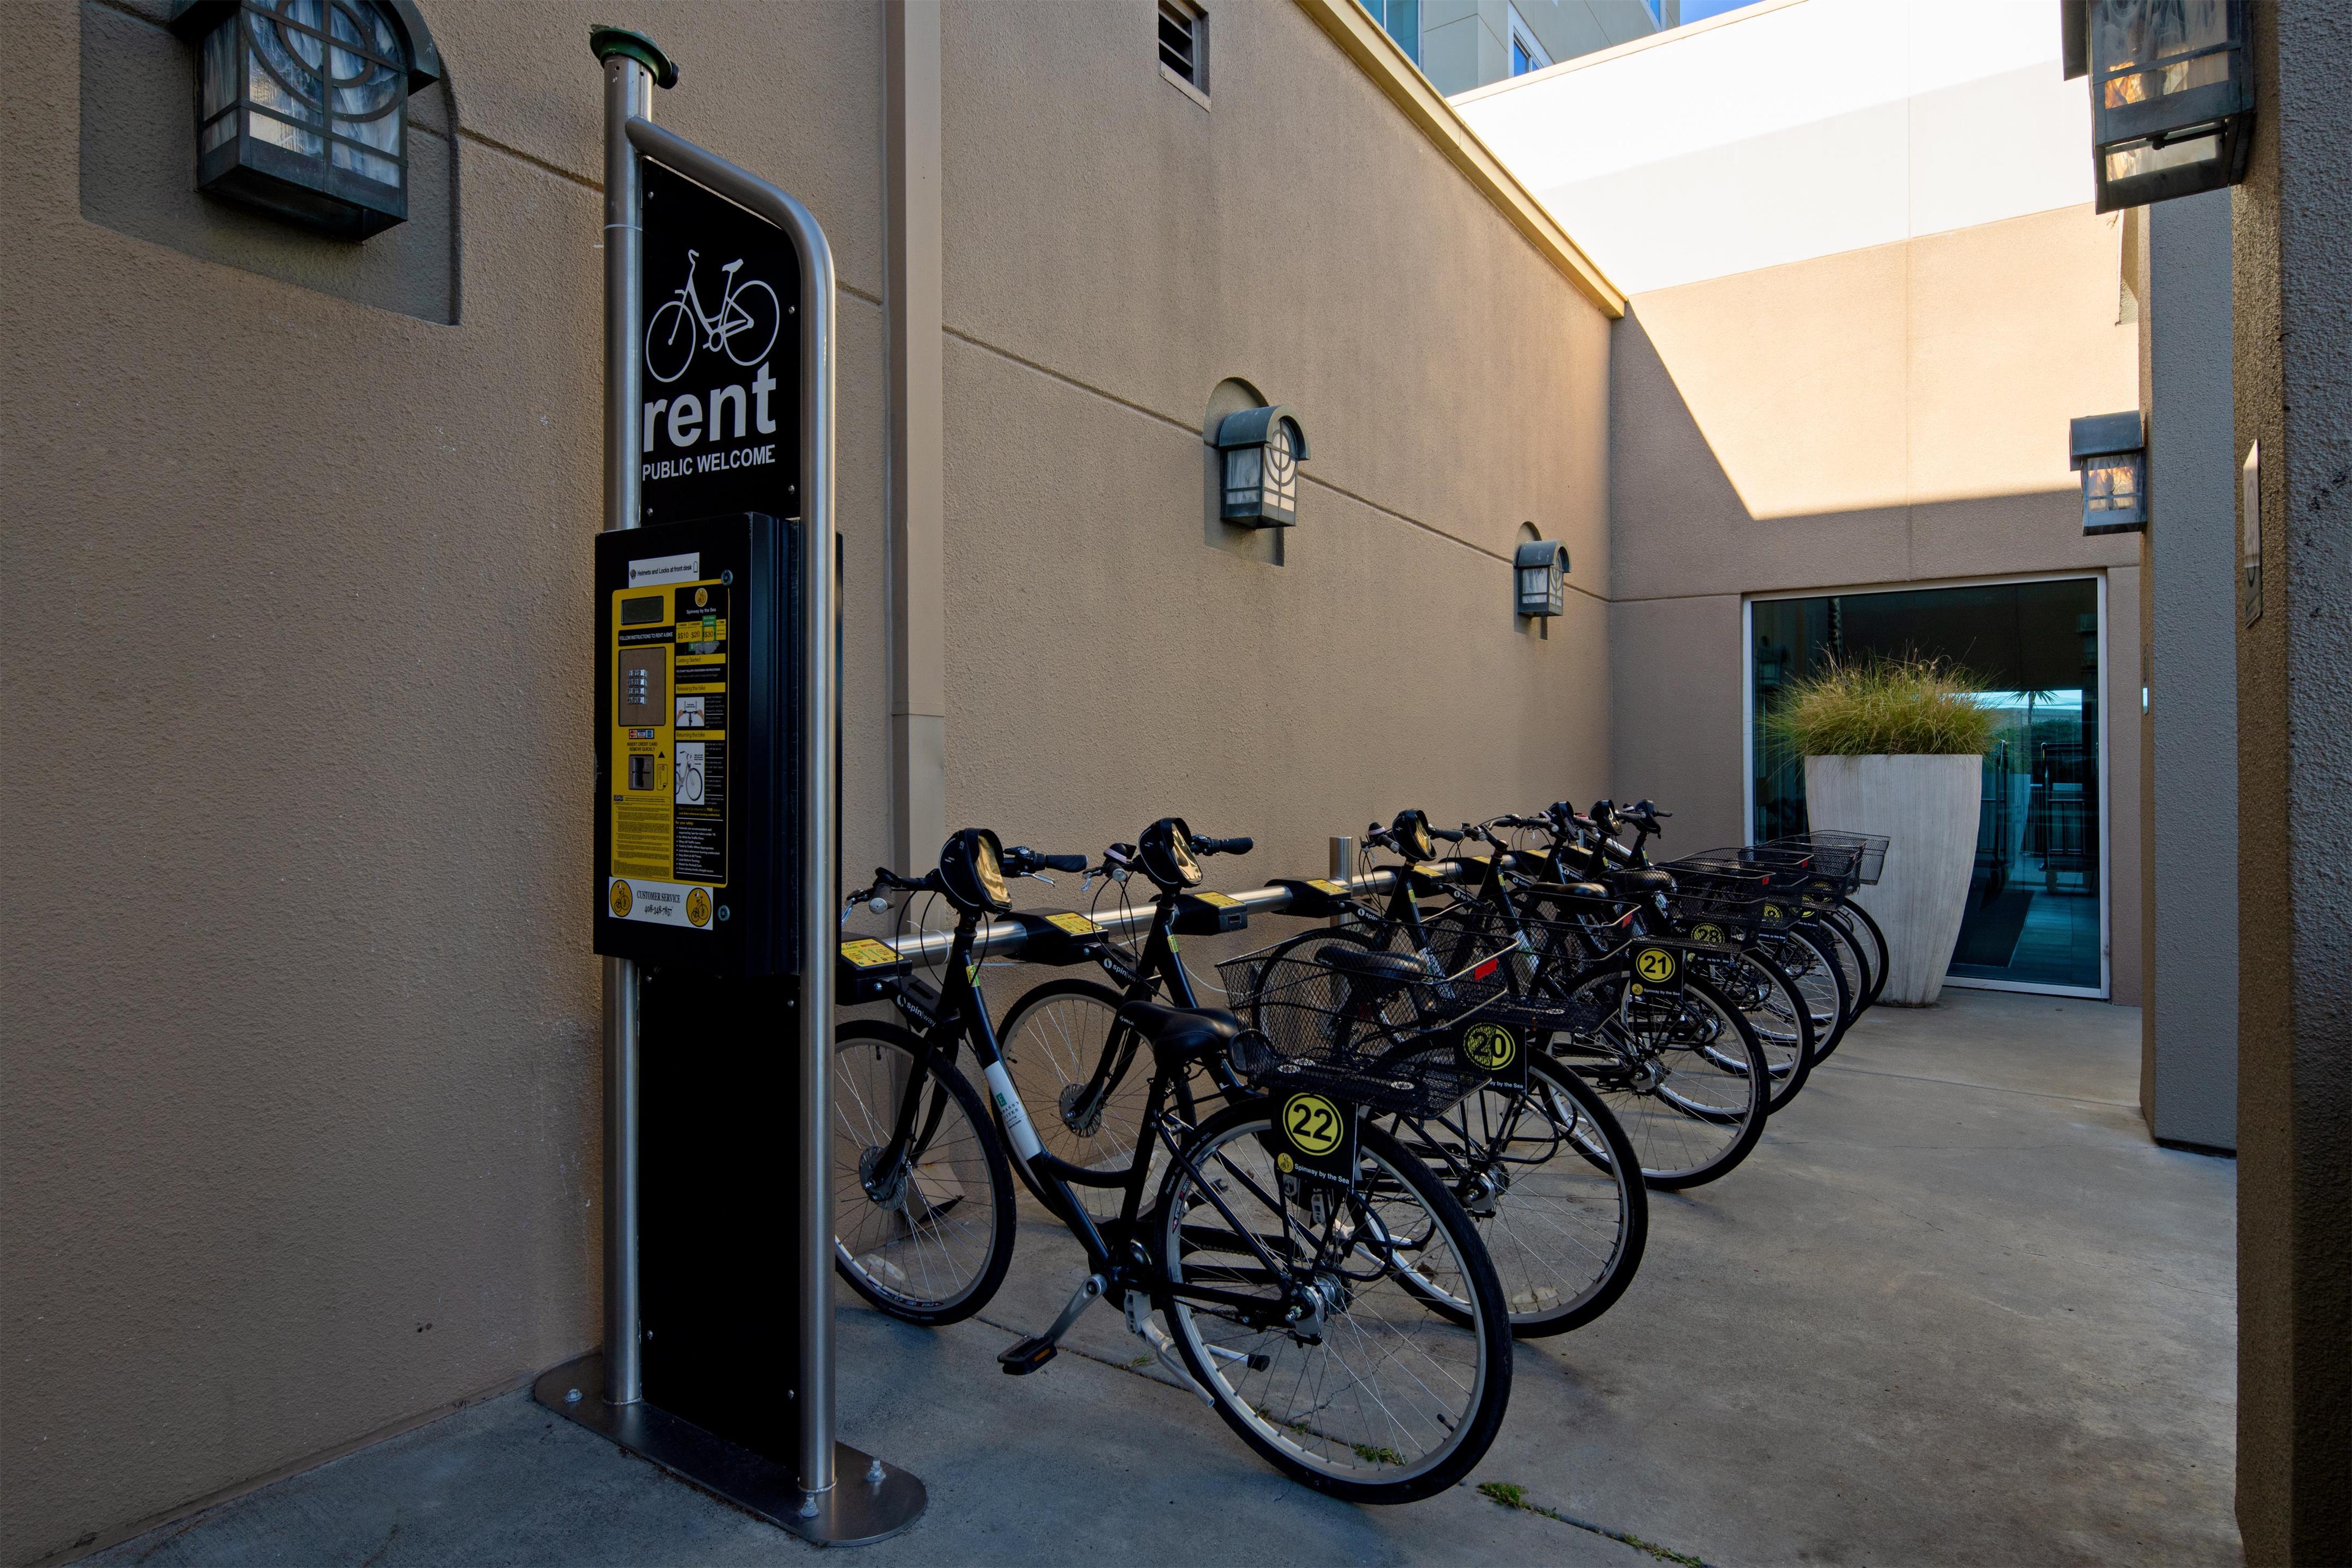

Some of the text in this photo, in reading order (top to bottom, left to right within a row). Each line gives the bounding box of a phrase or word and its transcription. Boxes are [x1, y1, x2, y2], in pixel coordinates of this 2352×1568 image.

[644, 361, 776, 452] rent
[642, 444, 775, 481] PUBLIC WELCOME
[691, 630, 700, 639] $20
[637, 890, 681, 903] CUSTOMER SERVICE
[645, 904, 673, 917] 408-348-7857
[1644, 955, 1667, 974] 21
[1473, 1031, 1506, 1058] 20
[1292, 1104, 1333, 1143] 22
[1294, 1163, 1318, 1176] Spinway
[1327, 1172, 1337, 1181] the
[1338, 1175, 1350, 1185] Sea
